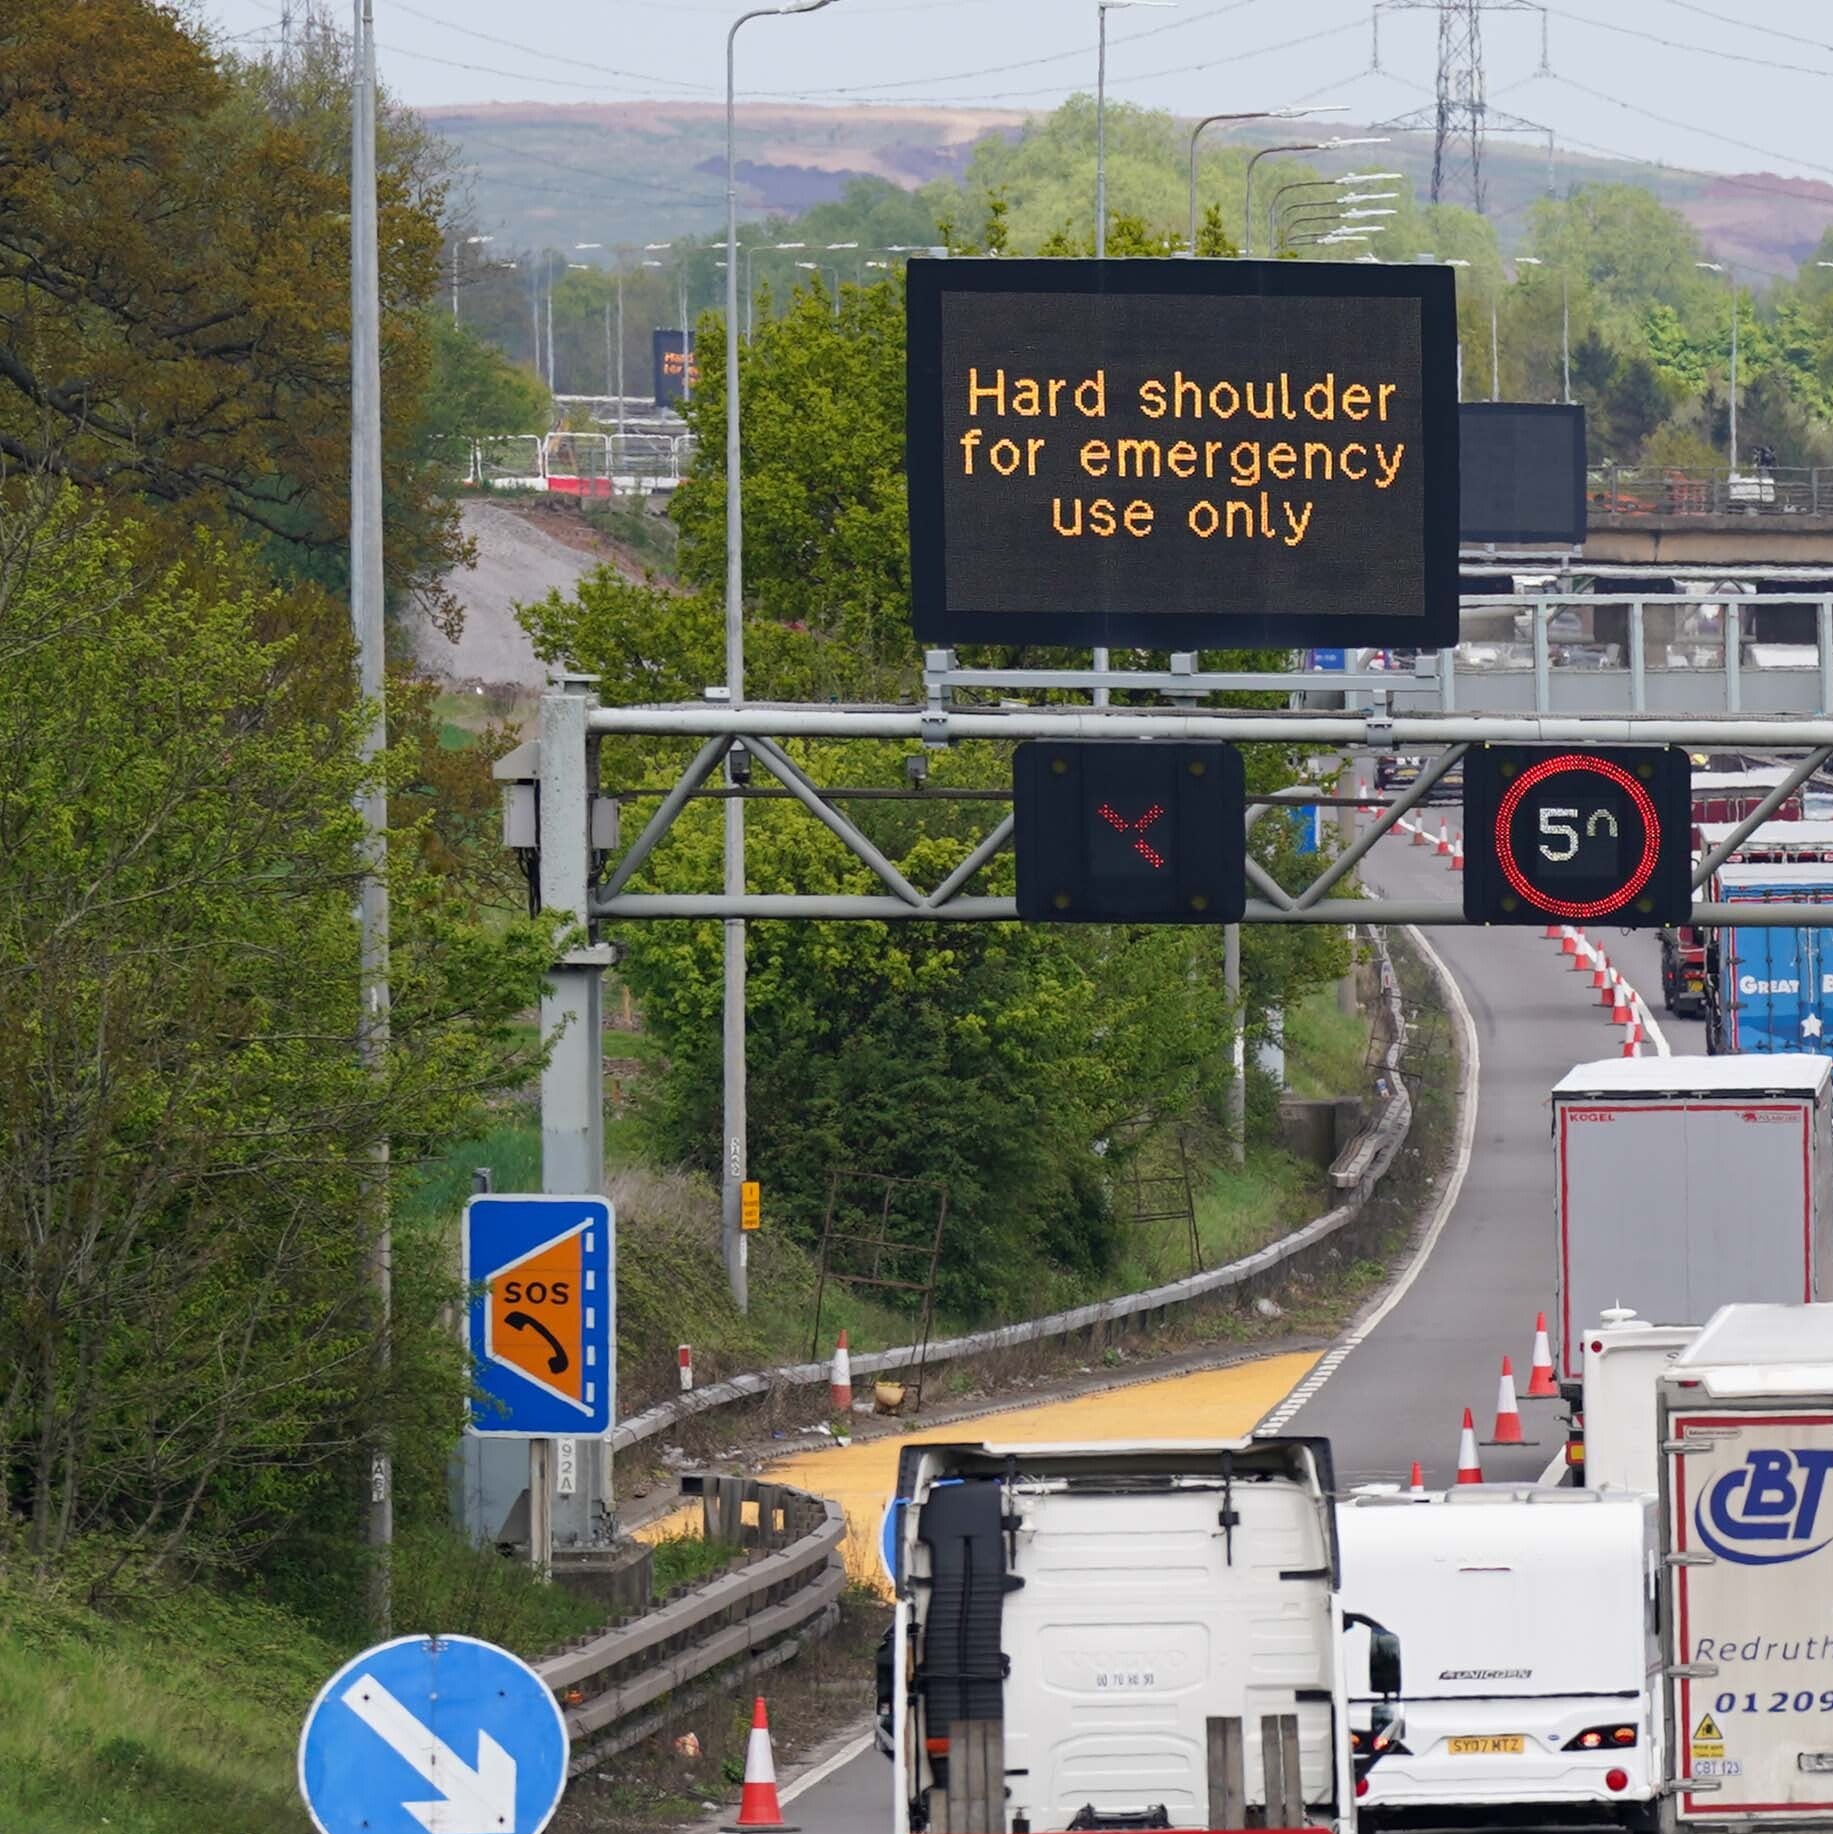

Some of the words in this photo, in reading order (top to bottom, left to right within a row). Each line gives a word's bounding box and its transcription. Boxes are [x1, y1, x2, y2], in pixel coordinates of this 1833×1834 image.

[968, 367, 1107, 418] Hard
[1139, 370, 1397, 423] shoulder
[961, 427, 1046, 476] for
[1080, 438, 1406, 489] emergency
[1053, 496, 1155, 537] use
[1189, 491, 1314, 547] only
[504, 1281, 571, 1305] SOS
[1453, 1739, 1489, 1752] SY07
